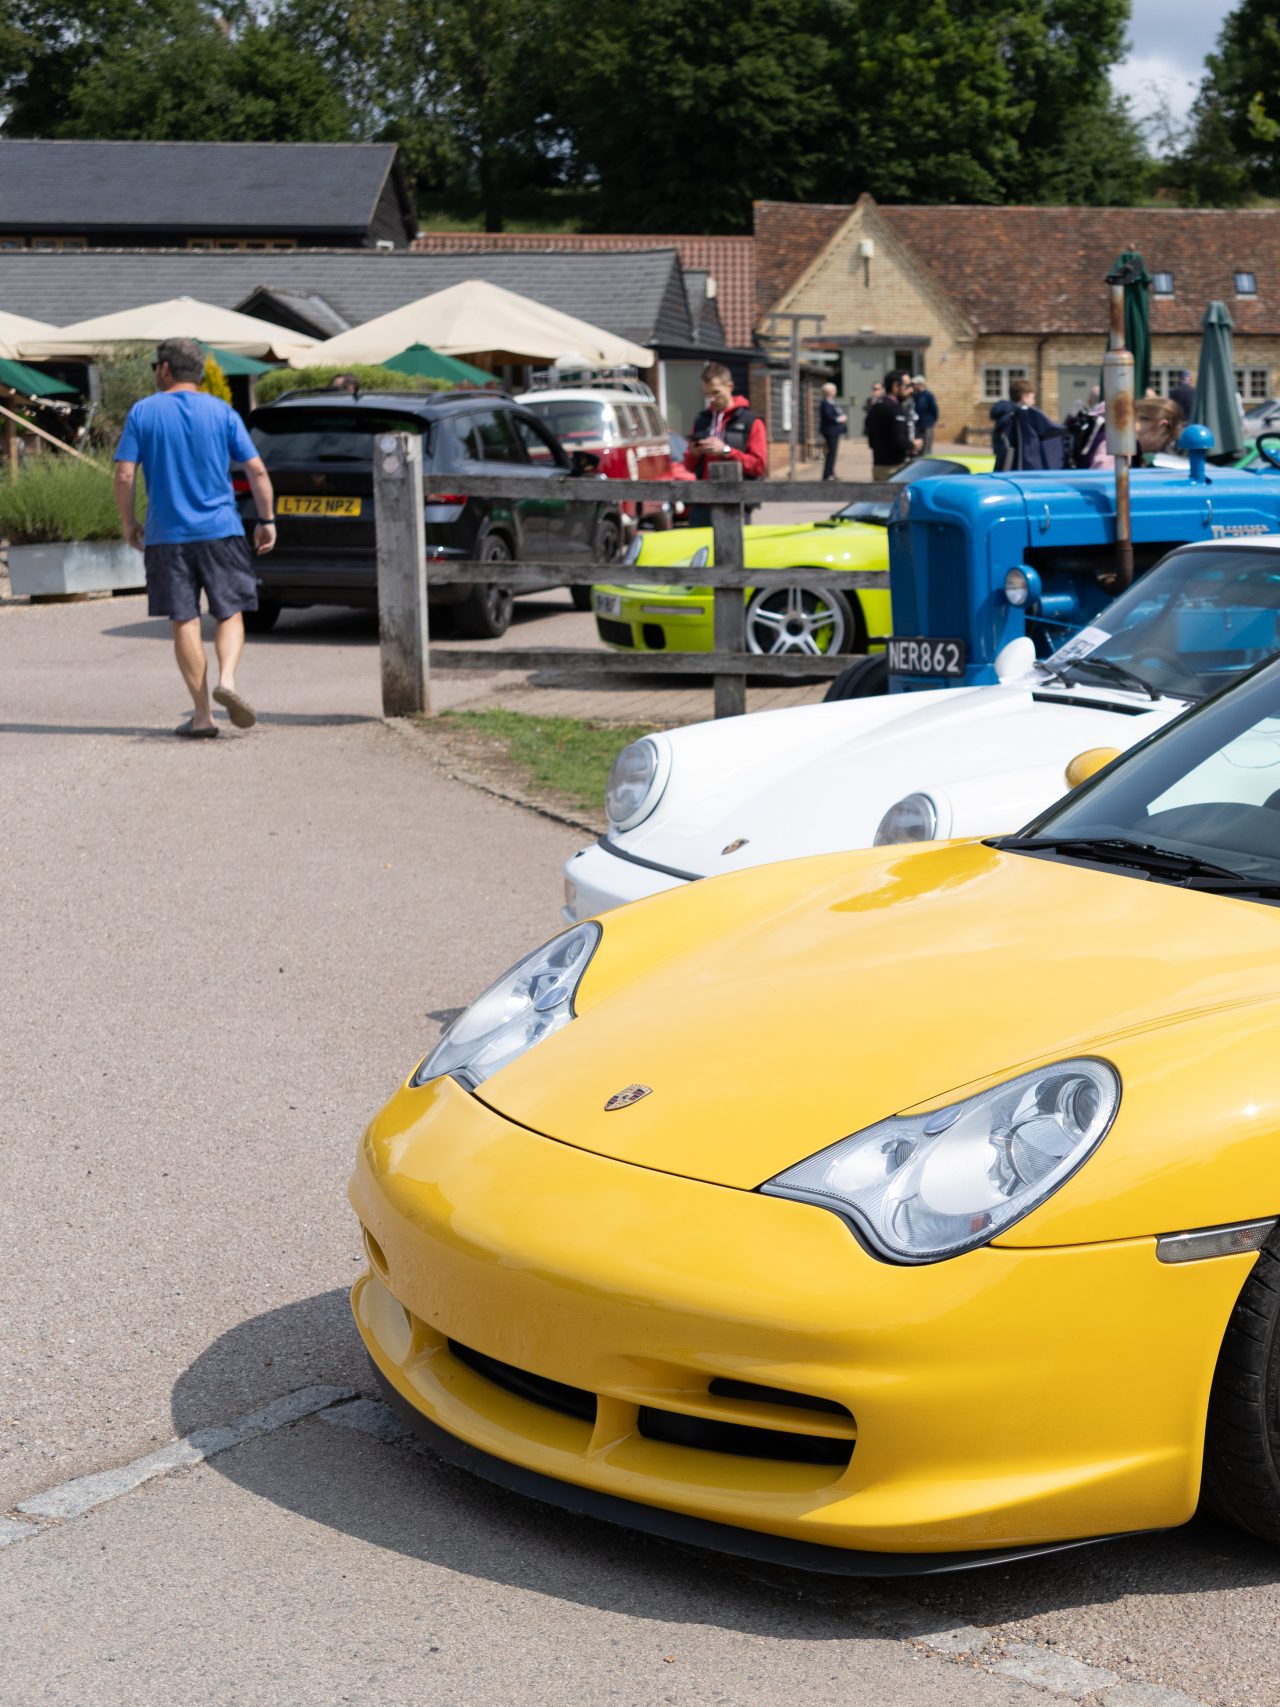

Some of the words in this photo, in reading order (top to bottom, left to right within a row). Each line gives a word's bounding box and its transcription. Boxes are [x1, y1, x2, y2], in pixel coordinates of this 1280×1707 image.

[283, 498, 322, 513] LT72
[325, 499, 355, 513] NPZ
[888, 641, 960, 673] NER862
